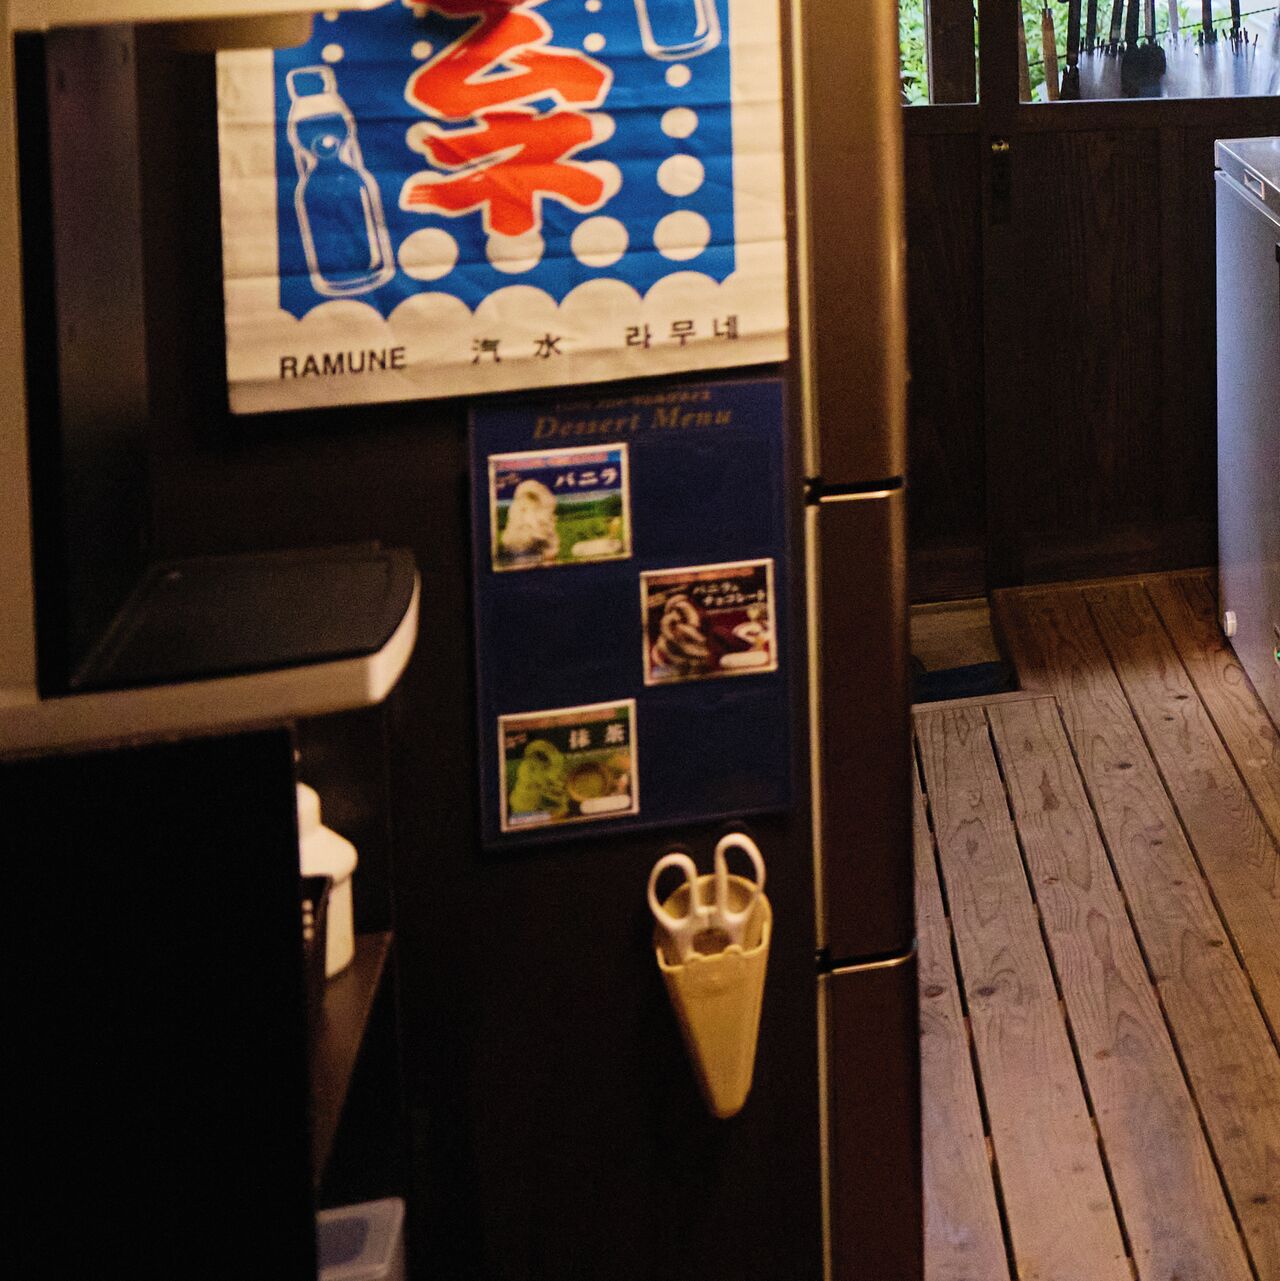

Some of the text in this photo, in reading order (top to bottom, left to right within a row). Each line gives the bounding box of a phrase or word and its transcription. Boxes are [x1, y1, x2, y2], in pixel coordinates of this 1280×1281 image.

[624, 315, 740, 350] 라무네
[279, 346, 408, 381] RAMUNE
[534, 405, 732, 440] Dessert Menu
